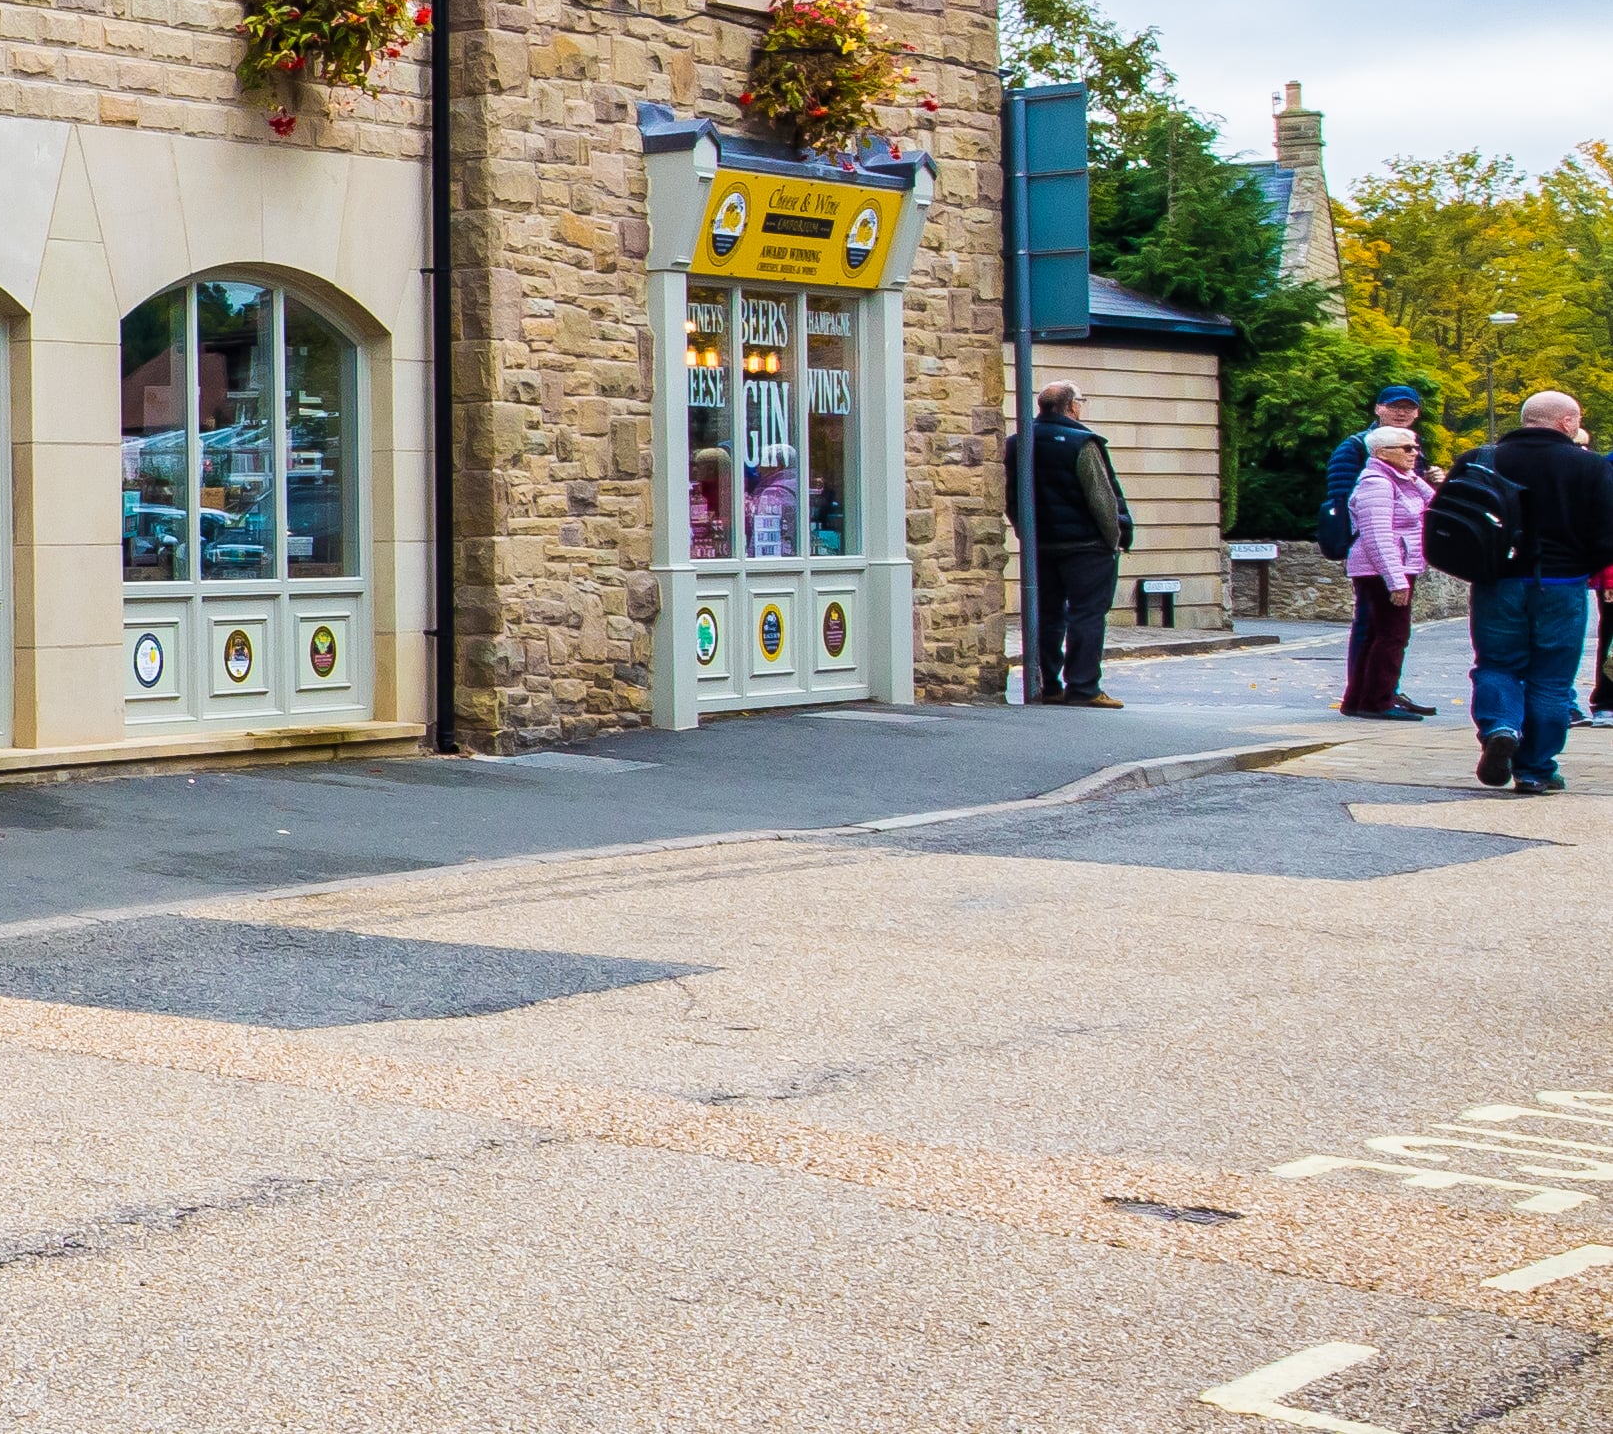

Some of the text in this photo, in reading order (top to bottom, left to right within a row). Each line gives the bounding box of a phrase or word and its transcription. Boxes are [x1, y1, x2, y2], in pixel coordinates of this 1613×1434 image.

[800, 193, 811, 212] &
[688, 303, 724, 333] TNEYS
[741, 298, 788, 347] BEERS
[808, 311, 851, 336] HAMPAGNE
[689, 366, 726, 407] EESE
[808, 368, 851, 414] WINES
[742, 379, 790, 468] GIN
[1231, 545, 1274, 553] RESCENT
